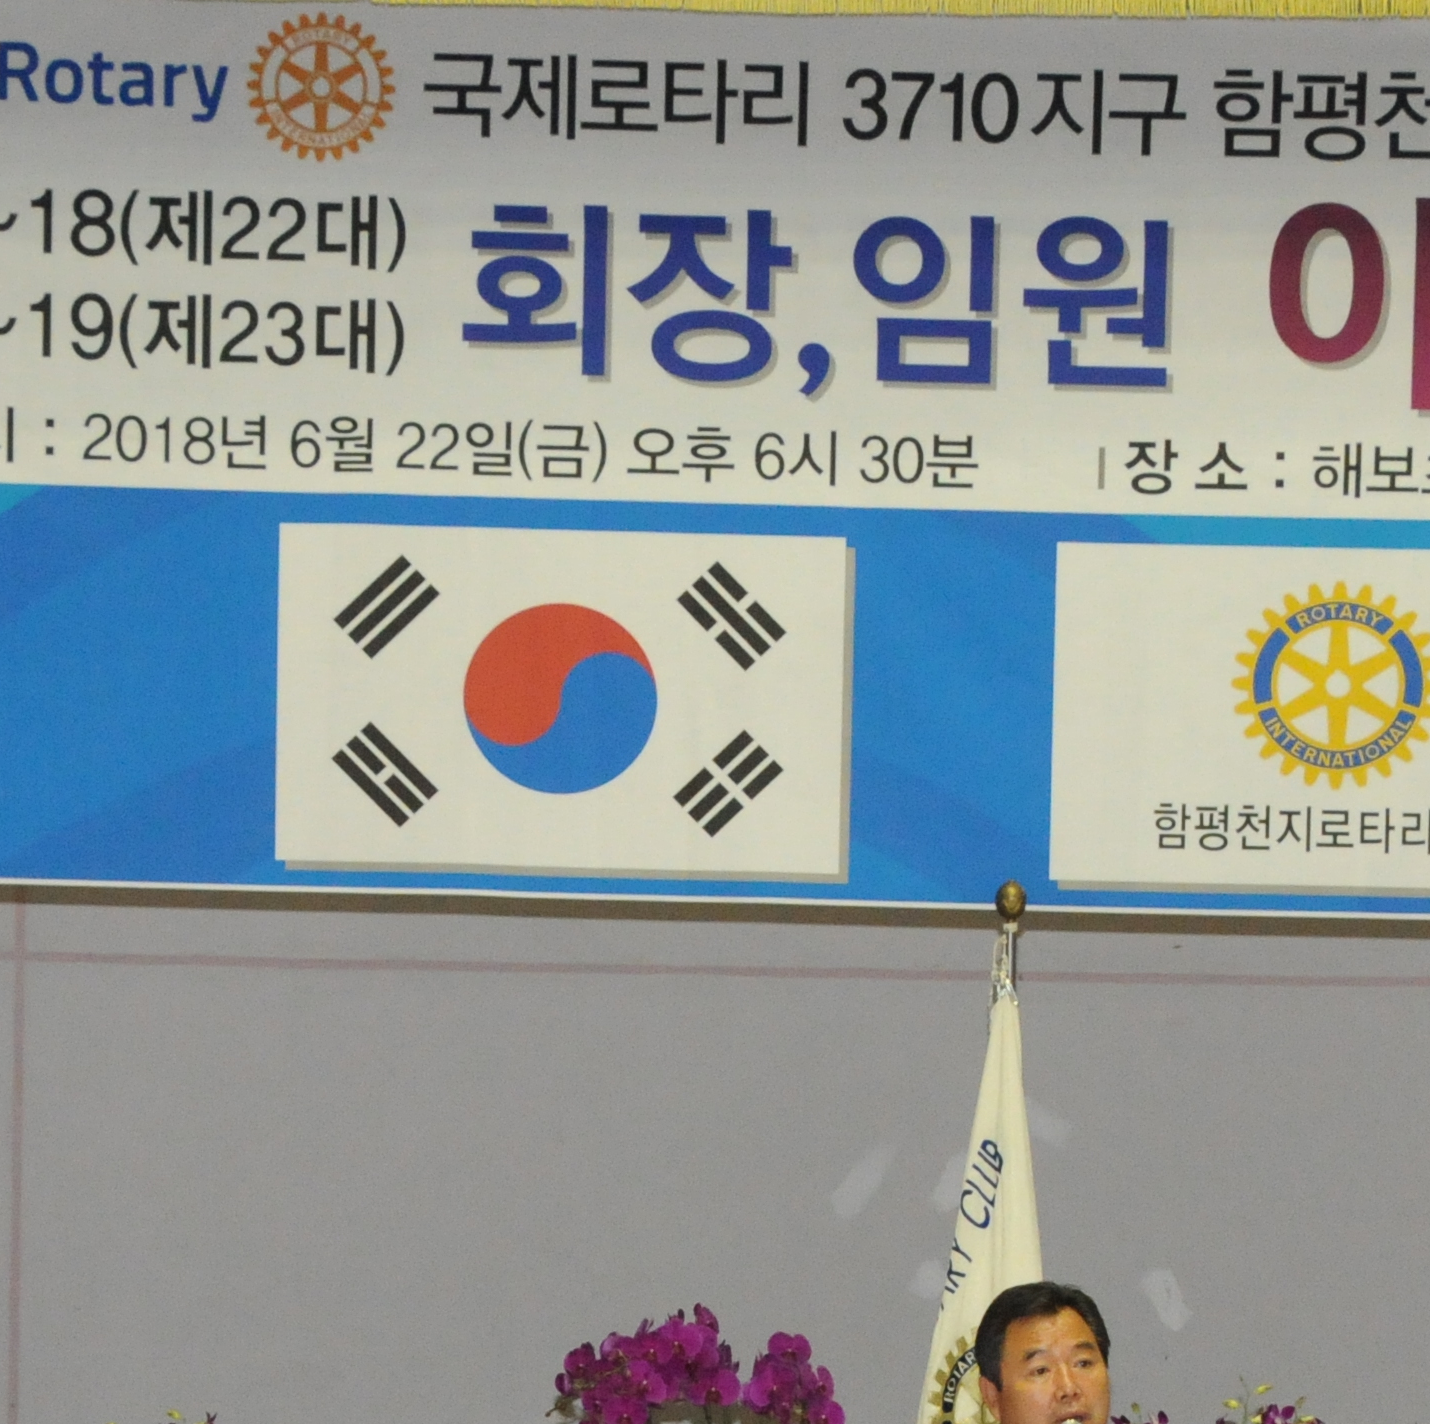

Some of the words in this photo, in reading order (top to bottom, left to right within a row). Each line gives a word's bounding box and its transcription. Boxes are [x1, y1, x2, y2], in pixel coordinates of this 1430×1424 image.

[424, 53, 810, 147] 국제로타리
[842, 68, 1187, 156] 3710지구
[462, 204, 1171, 397] 회장,임원
[82, 412, 269, 470] 2018년
[290, 420, 375, 474] 6월
[396, 418, 608, 482] 22일(금)
[626, 426, 735, 486] 오후
[753, 430, 838, 487] 6시
[859, 434, 980, 490] 30분
[1294, 603, 1385, 627] ROTARY
[1264, 716, 1413, 768] INTERNATIONAL
